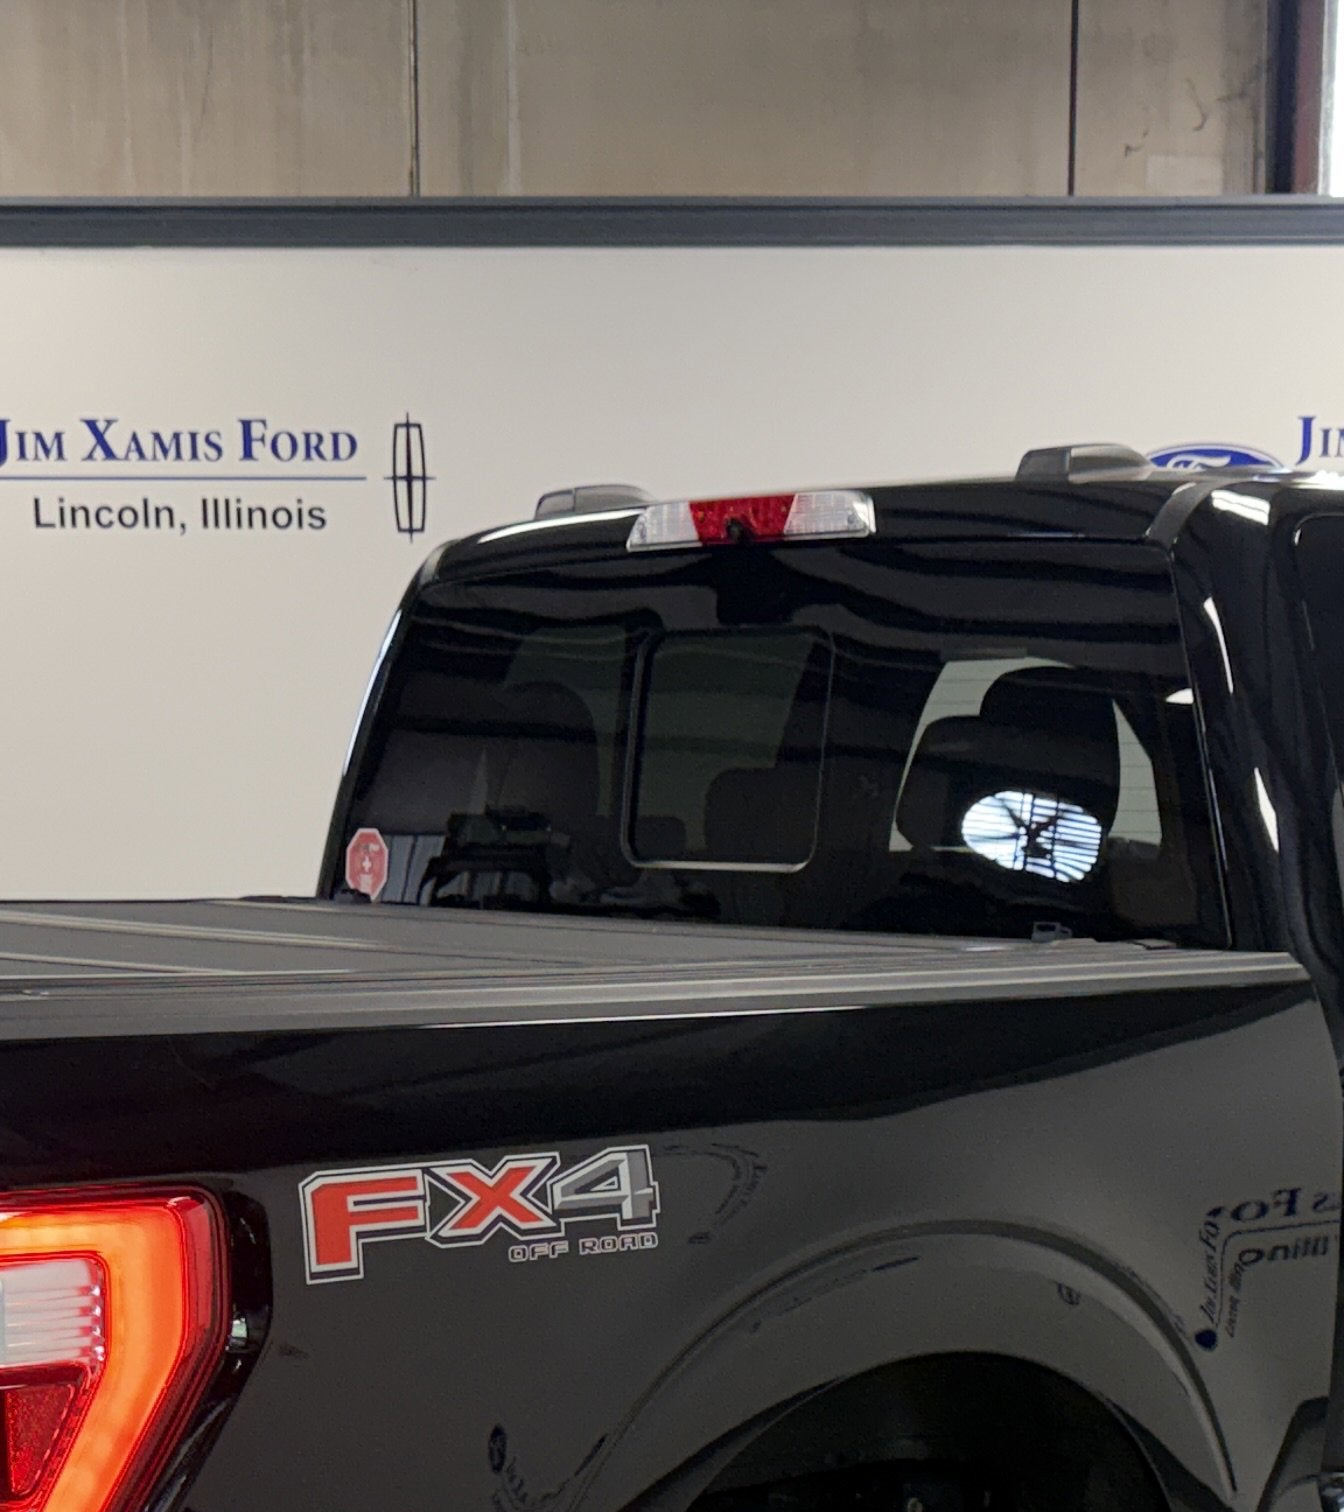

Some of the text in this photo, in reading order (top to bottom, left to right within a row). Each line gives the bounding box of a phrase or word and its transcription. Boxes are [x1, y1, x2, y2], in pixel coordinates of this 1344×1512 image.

[79, 418, 224, 462] XAMIS
[237, 418, 358, 463] FORD
[33, 497, 327, 534] Lincoln, Illinois
[298, 1144, 660, 1285] FX4
[508, 1231, 659, 1263] OFF ROAD
